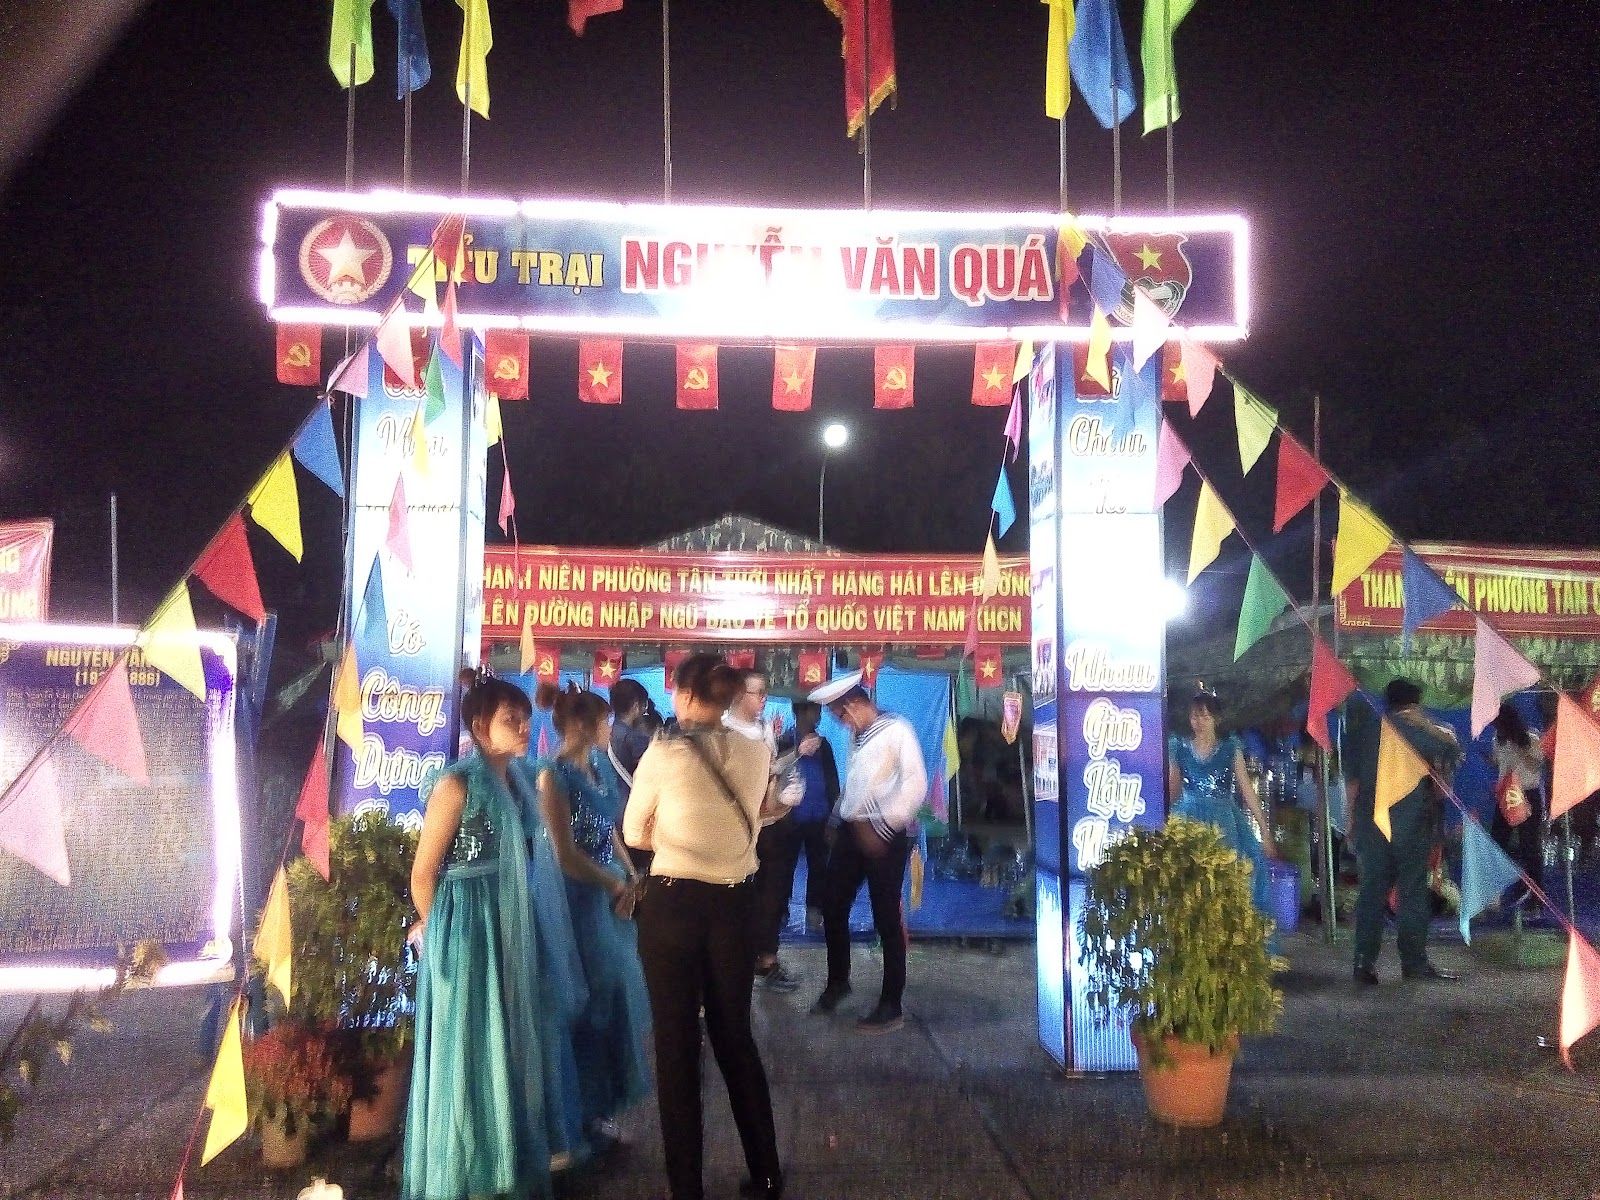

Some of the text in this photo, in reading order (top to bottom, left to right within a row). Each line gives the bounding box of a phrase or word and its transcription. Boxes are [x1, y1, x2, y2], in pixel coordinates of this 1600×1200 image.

[511, 251, 604, 295] TRẠI
[840, 236, 937, 296] VĂN
[953, 237, 1050, 303] QUÁ
[539, 561, 585, 591] NIÊN
[592, 562, 671, 592] PHƯỜNG
[677, 567, 715, 593] TÂN
[774, 564, 825, 595] NHẤT
[890, 566, 922, 596] HÁI
[929, 566, 966, 596] LÊN
[600, 597, 654, 632] NHẬP
[660, 602, 698, 629] NGŨ
[783, 599, 809, 631] TỔ
[816, 601, 868, 634] QUỐC
[874, 600, 917, 635] VIỆT
[923, 604, 965, 631] NAM
[361, 668, 446, 735] Công
[1084, 759, 1145, 821] Lấy
